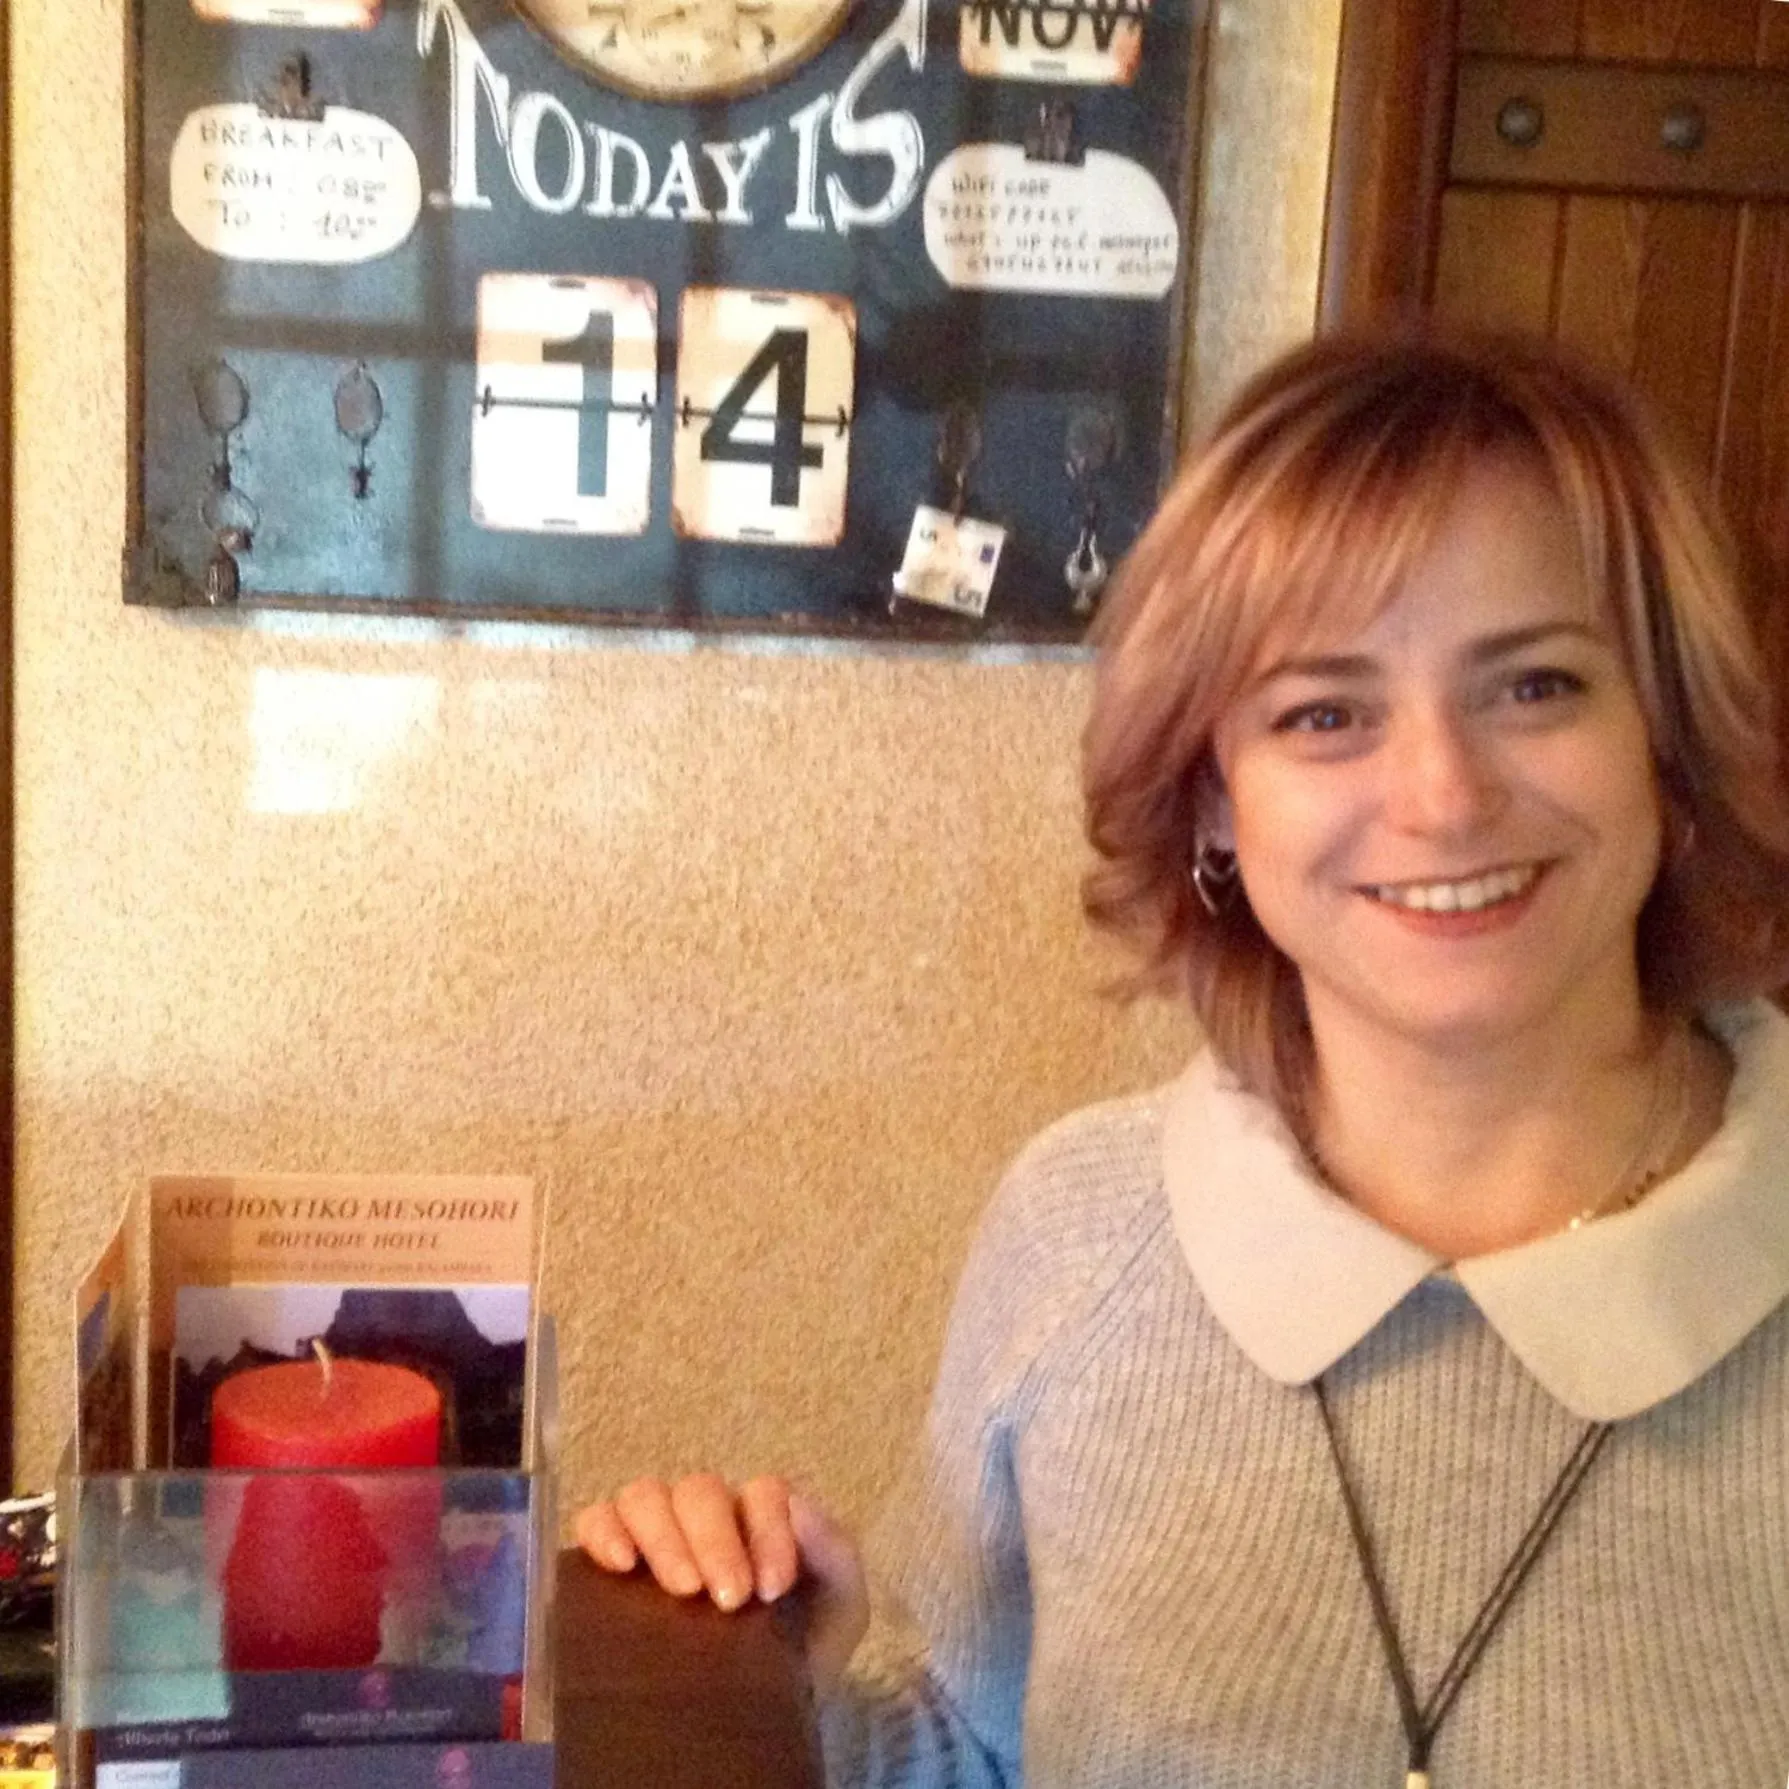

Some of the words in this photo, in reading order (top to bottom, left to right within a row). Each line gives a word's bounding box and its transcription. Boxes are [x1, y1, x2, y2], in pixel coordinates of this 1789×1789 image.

[978, 0, 1128, 52] NOV
[785, 0, 926, 235] IS
[200, 120, 394, 162] BREAKFAST
[203, 163, 273, 189] FROM
[168, 1196, 360, 1222] ARCHONTIKO
[366, 1198, 520, 1222] MESOHORI
[257, 1230, 364, 1250] BOUTIQUE
[372, 1231, 440, 1250] HOTEL
